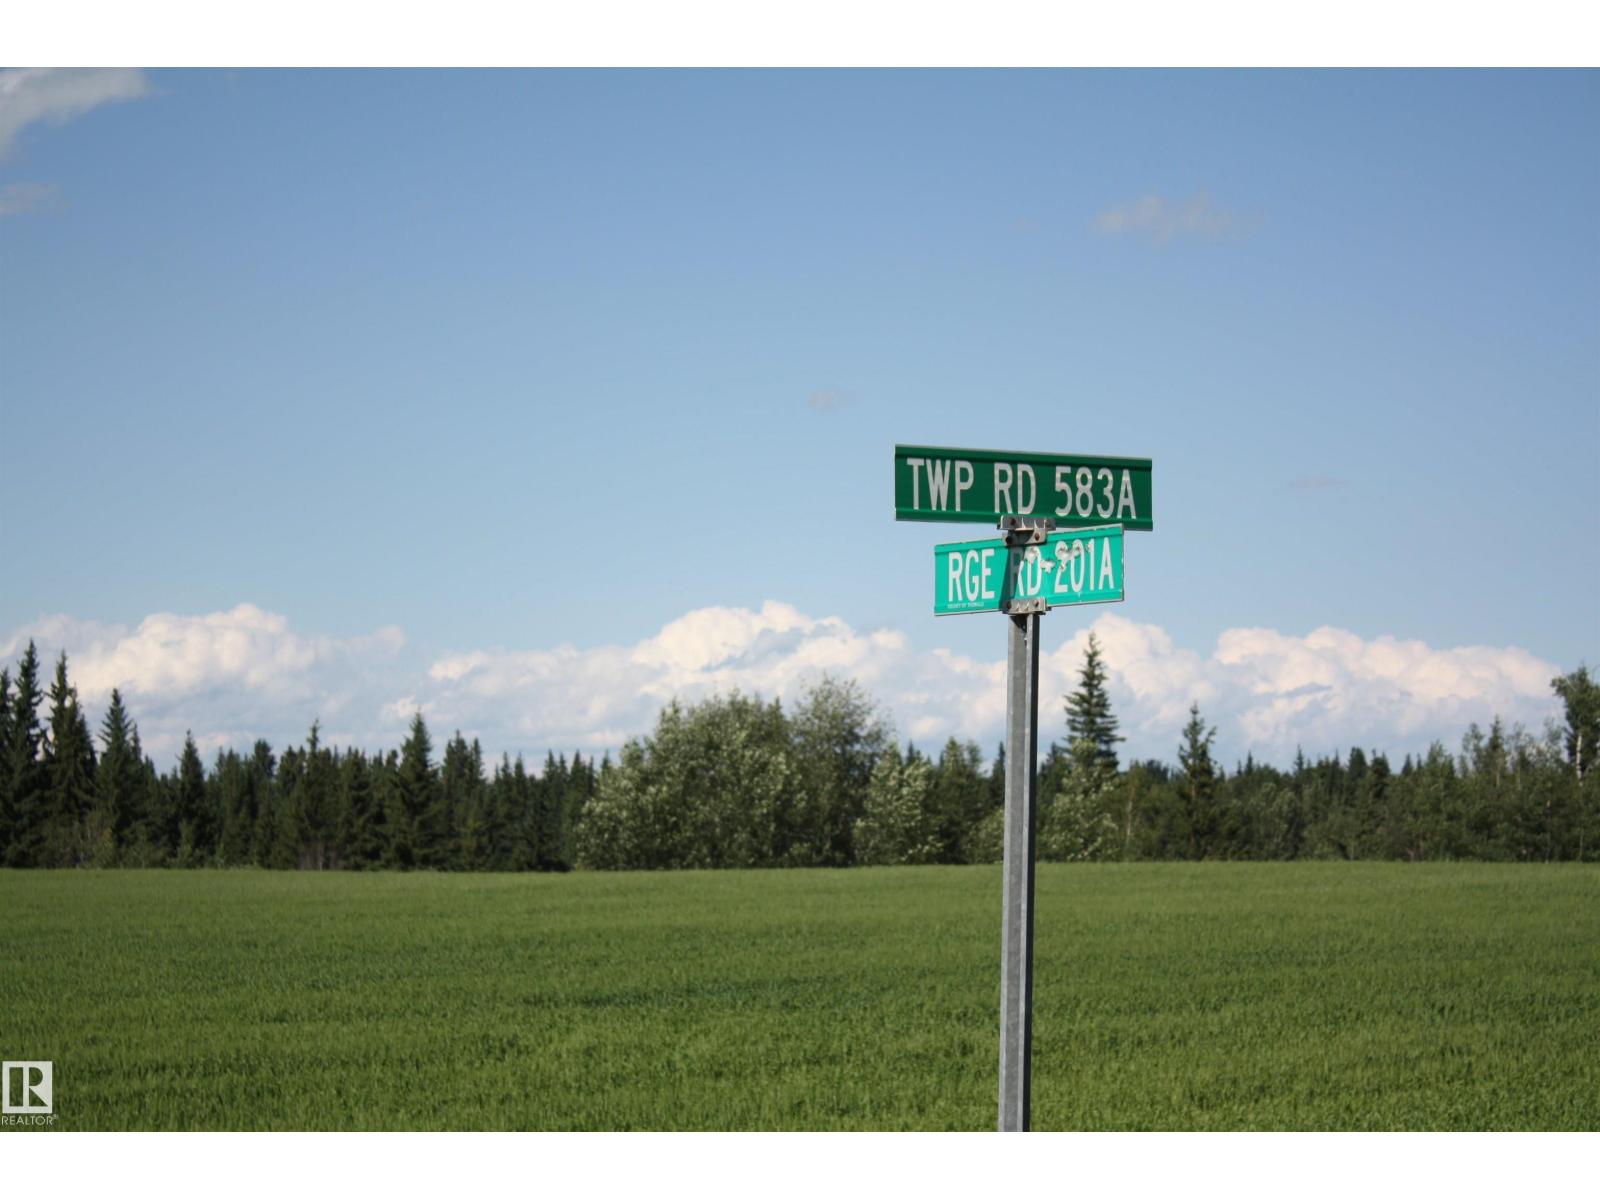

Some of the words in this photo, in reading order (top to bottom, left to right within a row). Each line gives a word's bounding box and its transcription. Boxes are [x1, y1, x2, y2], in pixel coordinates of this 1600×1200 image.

[906, 457, 974, 512] TWP
[993, 462, 1037, 515] RD
[1054, 465, 1137, 520] 583A
[948, 548, 995, 603] RGE
